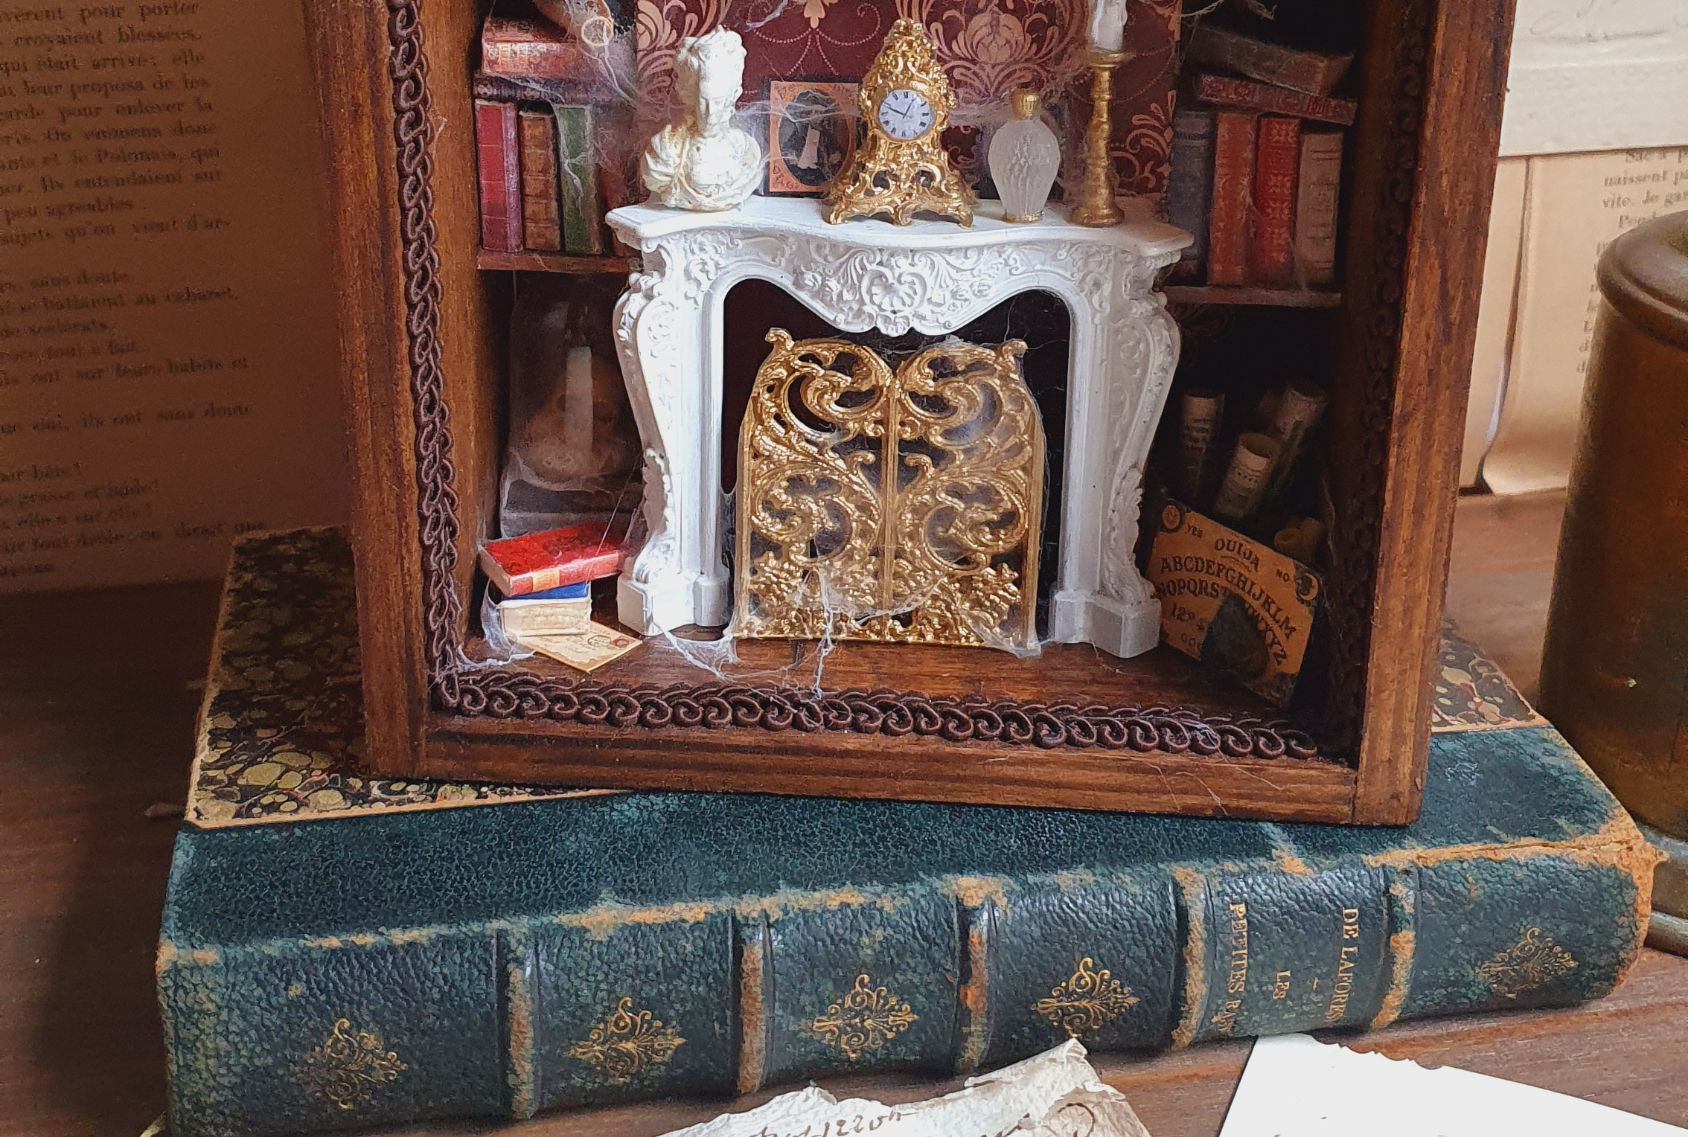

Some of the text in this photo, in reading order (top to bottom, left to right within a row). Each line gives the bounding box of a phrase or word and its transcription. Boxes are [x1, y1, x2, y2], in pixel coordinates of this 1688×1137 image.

[1214, 537, 1261, 573] OUIJA
[1274, 567, 1291, 584] NO
[1341, 907, 1360, 941] DE
[1227, 902, 1249, 994] PETITES
